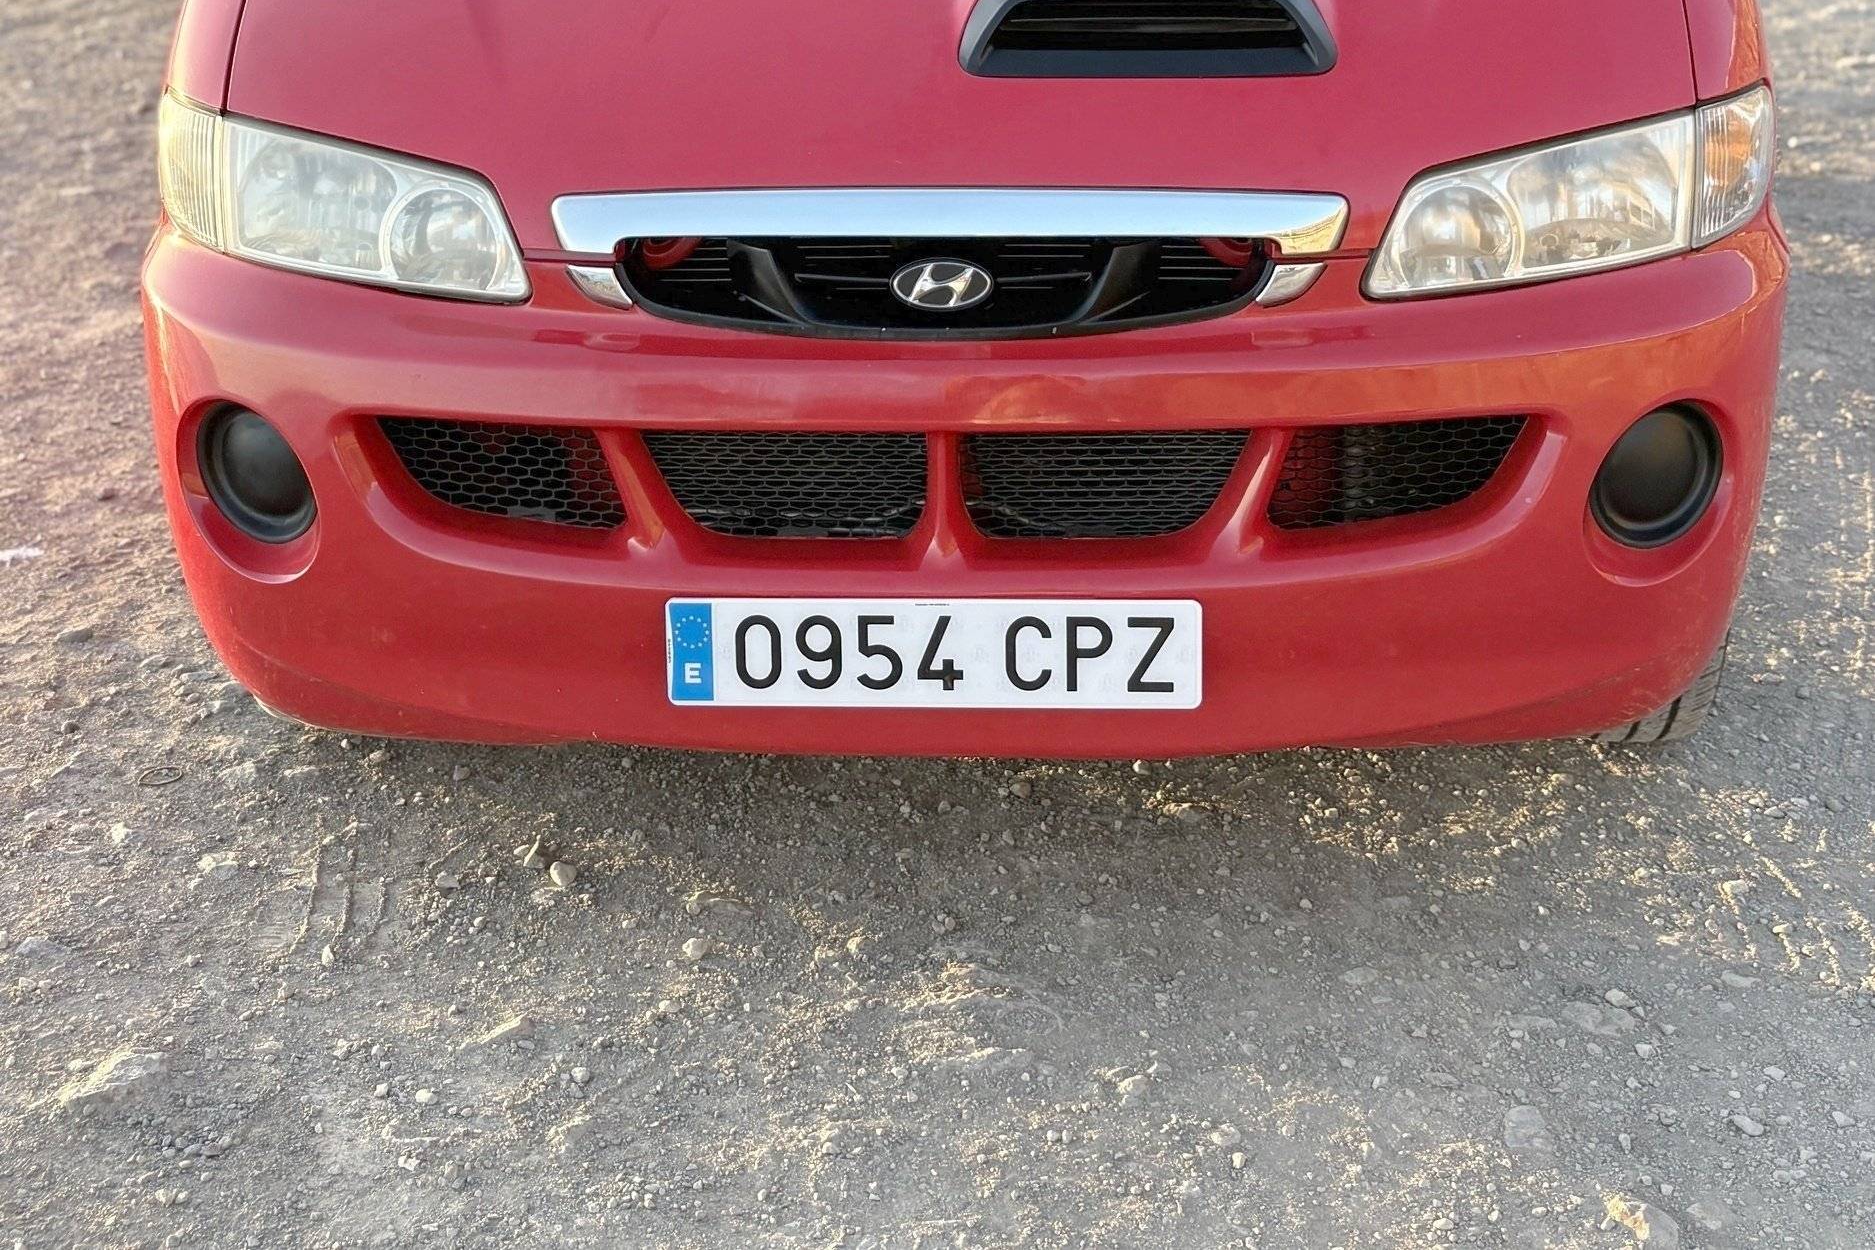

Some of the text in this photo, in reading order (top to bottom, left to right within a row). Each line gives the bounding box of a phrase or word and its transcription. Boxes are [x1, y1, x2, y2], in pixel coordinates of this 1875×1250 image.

[684, 662, 702, 684] E
[735, 614, 1175, 693] 0954 CPZ
